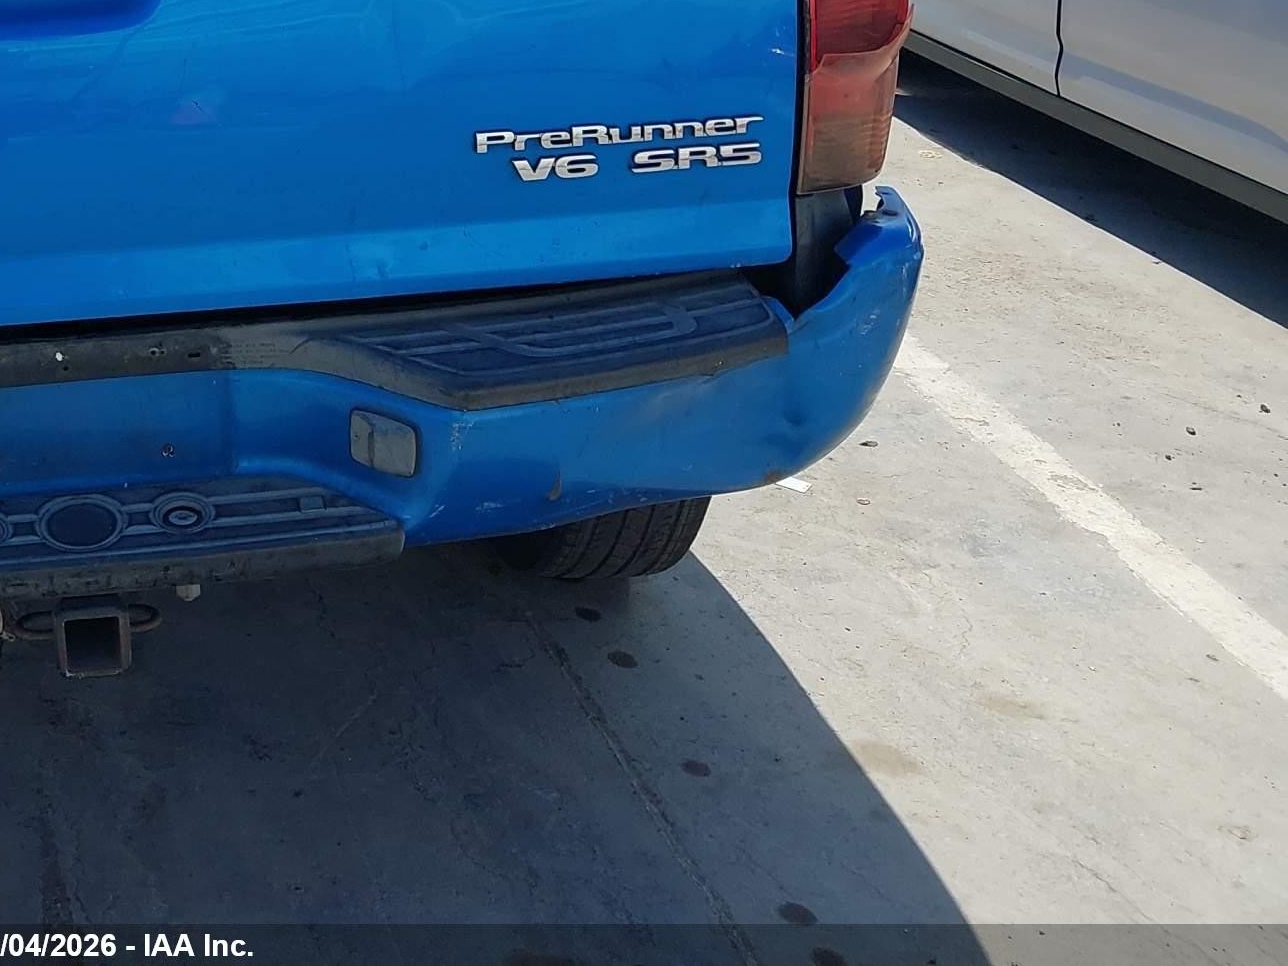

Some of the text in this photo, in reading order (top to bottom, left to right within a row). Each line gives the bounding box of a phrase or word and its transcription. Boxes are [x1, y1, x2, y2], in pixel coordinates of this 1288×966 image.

[475, 116, 764, 154] PreRunner
[511, 142, 762, 181] V6 SR5
